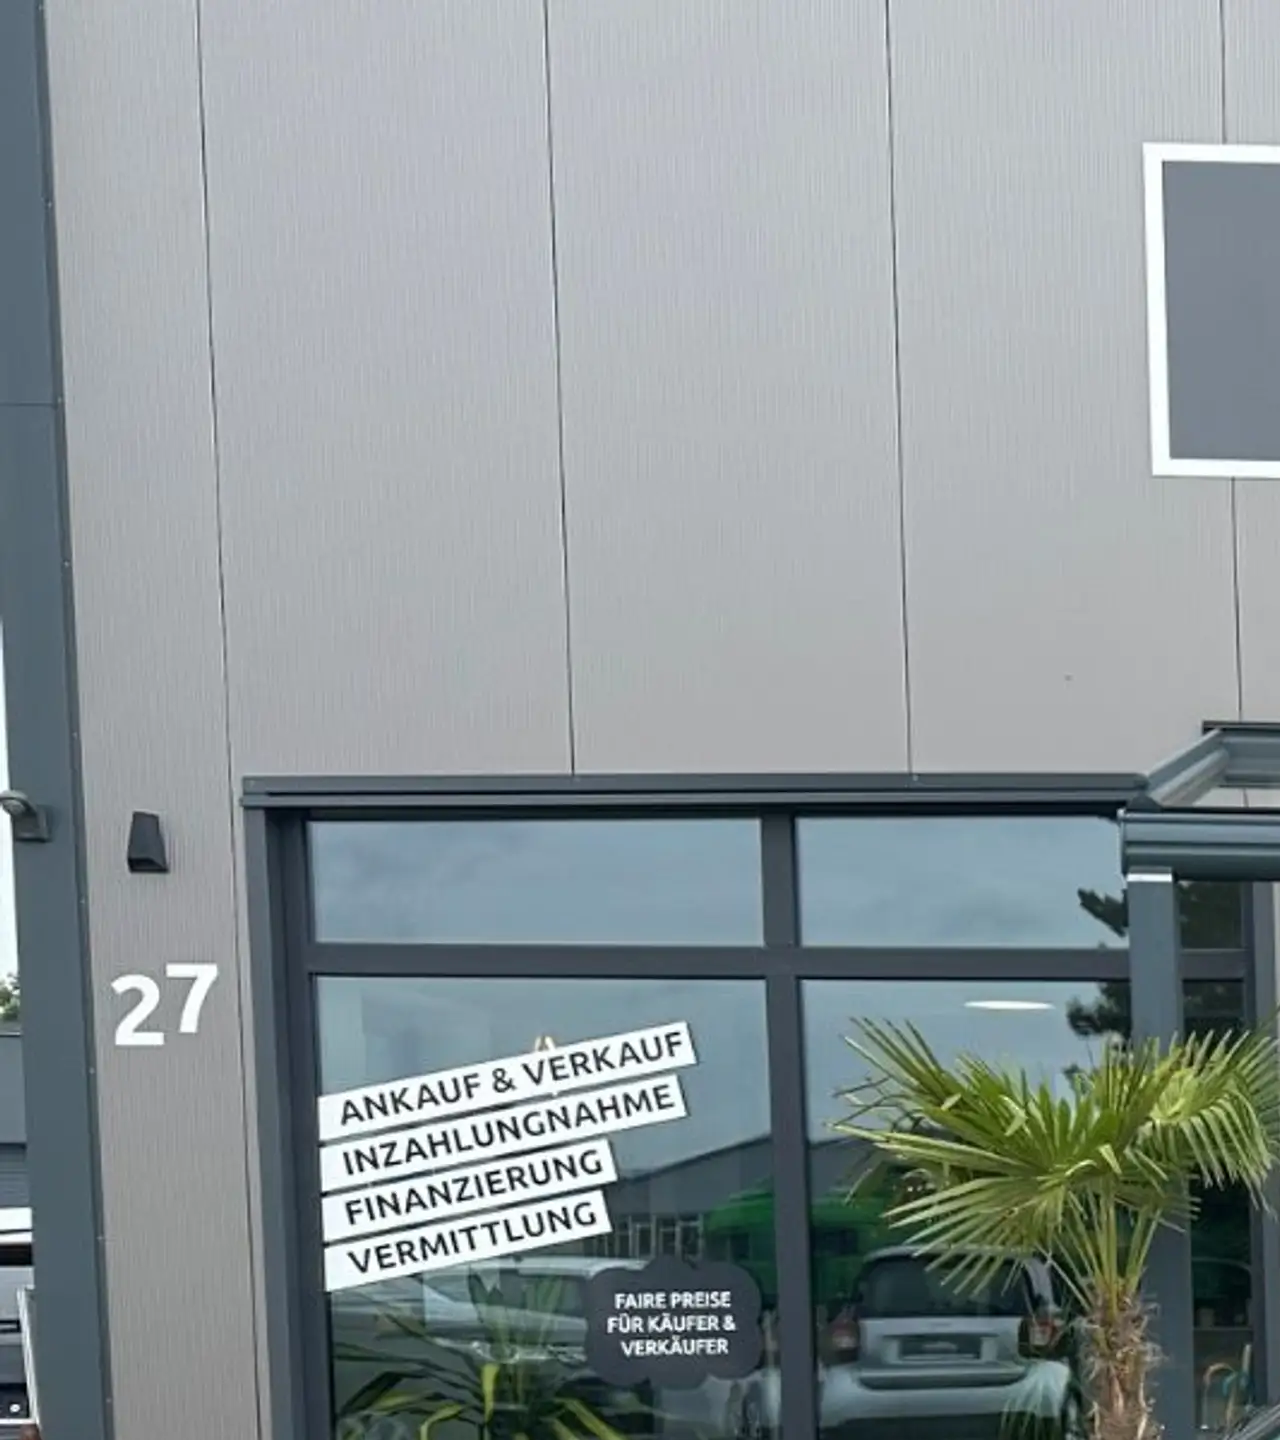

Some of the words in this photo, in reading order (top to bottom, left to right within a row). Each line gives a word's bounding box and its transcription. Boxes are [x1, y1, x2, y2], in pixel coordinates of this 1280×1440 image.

[110, 961, 218, 1046] 27
[340, 1072, 482, 1126] ANKAUF
[492, 1068, 516, 1094] &
[522, 1032, 683, 1087] VERKAUF
[343, 1084, 676, 1176] INZAHLUNGNAHME
[345, 1150, 602, 1226] FINANZIERUNG
[348, 1202, 597, 1275] VERMITTLUNG
[606, 1312, 644, 1333] FÜR
[647, 1312, 720, 1333] KÄUFER
[722, 1314, 737, 1331] &
[614, 1292, 666, 1309] FAIRE
[670, 1291, 732, 1309] PREISE
[620, 1335, 729, 1357] VERKÄUFER
